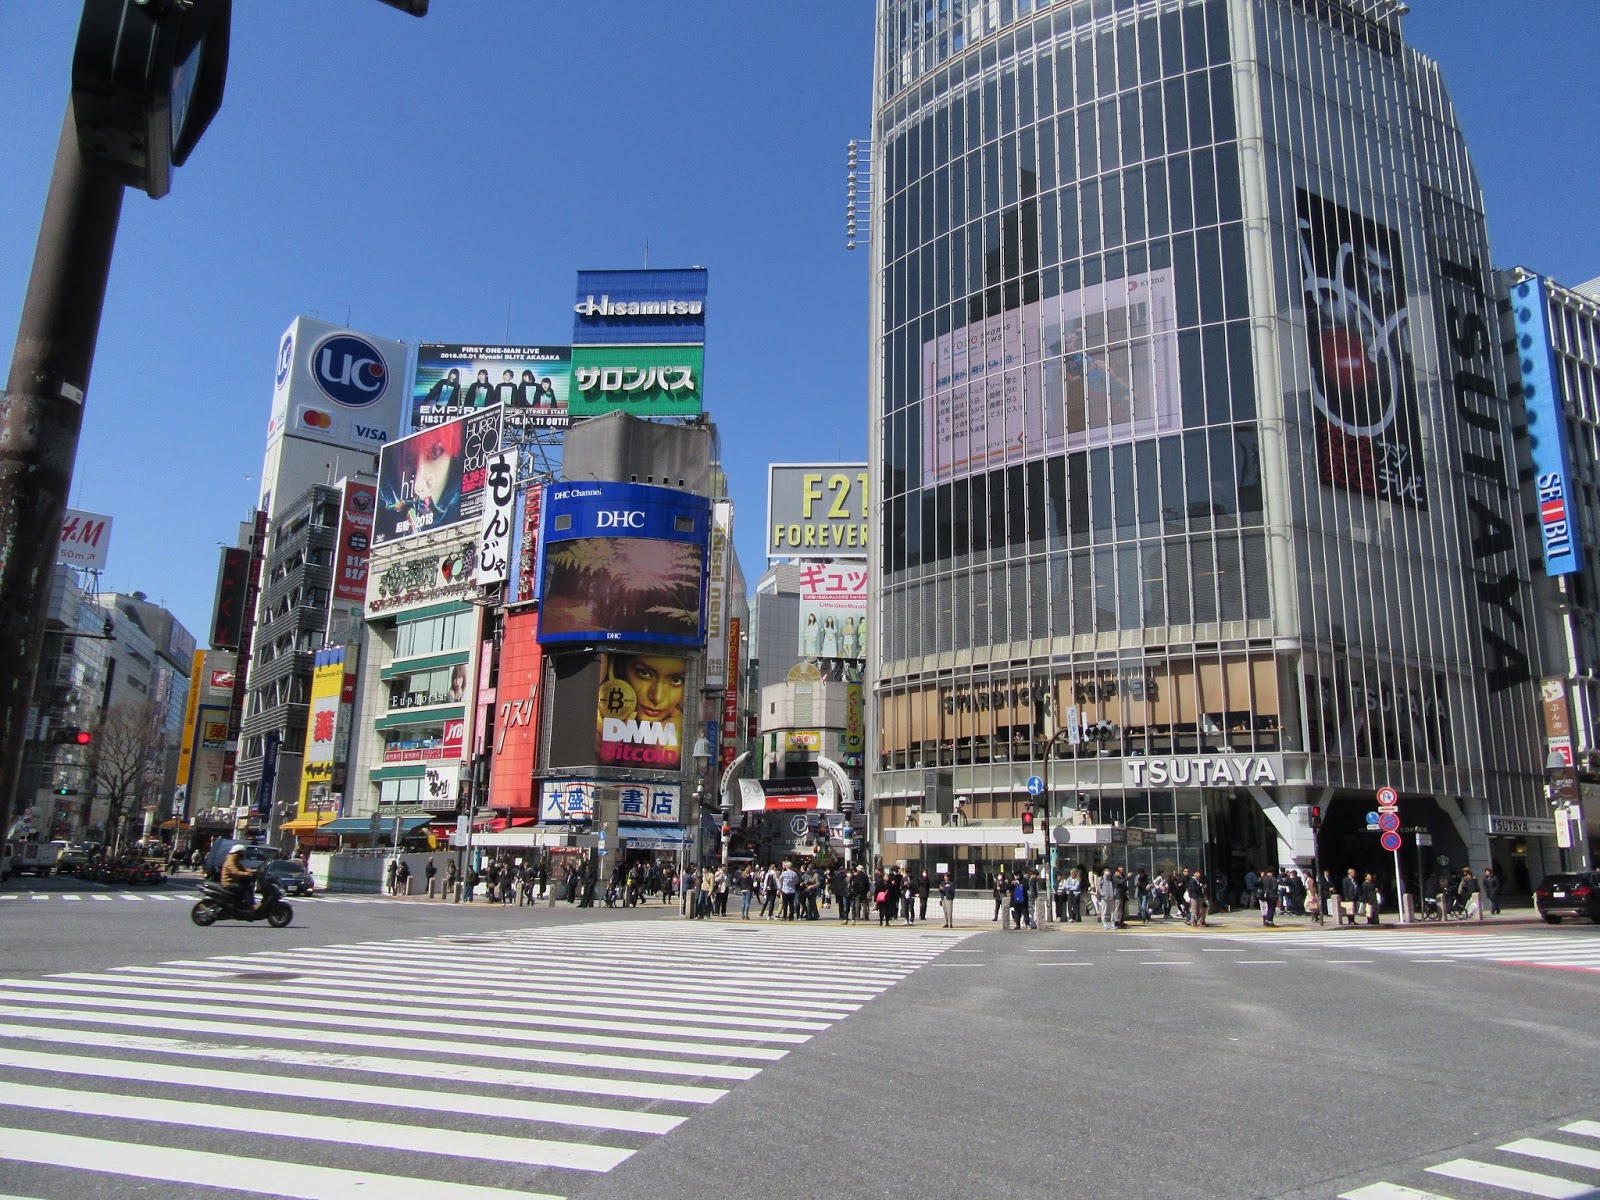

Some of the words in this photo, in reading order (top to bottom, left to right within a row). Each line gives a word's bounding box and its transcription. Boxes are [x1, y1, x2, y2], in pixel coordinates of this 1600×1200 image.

[574, 295, 702, 316] Hisamitsu
[575, 366, 694, 391] サロンパス
[354, 424, 389, 443] VISA
[465, 414, 501, 439] HURRY
[465, 427, 499, 460] GO
[400, 465, 436, 501] hide
[554, 490, 570, 500] DHC
[571, 488, 602, 498] Channel
[480, 453, 513, 578] もんじゃ
[596, 511, 645, 528] DHC
[1538, 473, 1572, 560] SEIBU
[60, 516, 106, 548] H&M
[60, 549, 84, 560] 50m
[606, 632, 621, 640] DHC
[313, 710, 335, 743] 薬
[497, 683, 538, 755] クスリ
[445, 722, 464, 742] JTB
[602, 717, 678, 747] DMM
[601, 740, 677, 764] Bitcoin
[1128, 757, 1276, 785] TSUTAYA
[547, 788, 674, 815] 大盛書店
[1492, 819, 1528, 832] TSUTAYA
